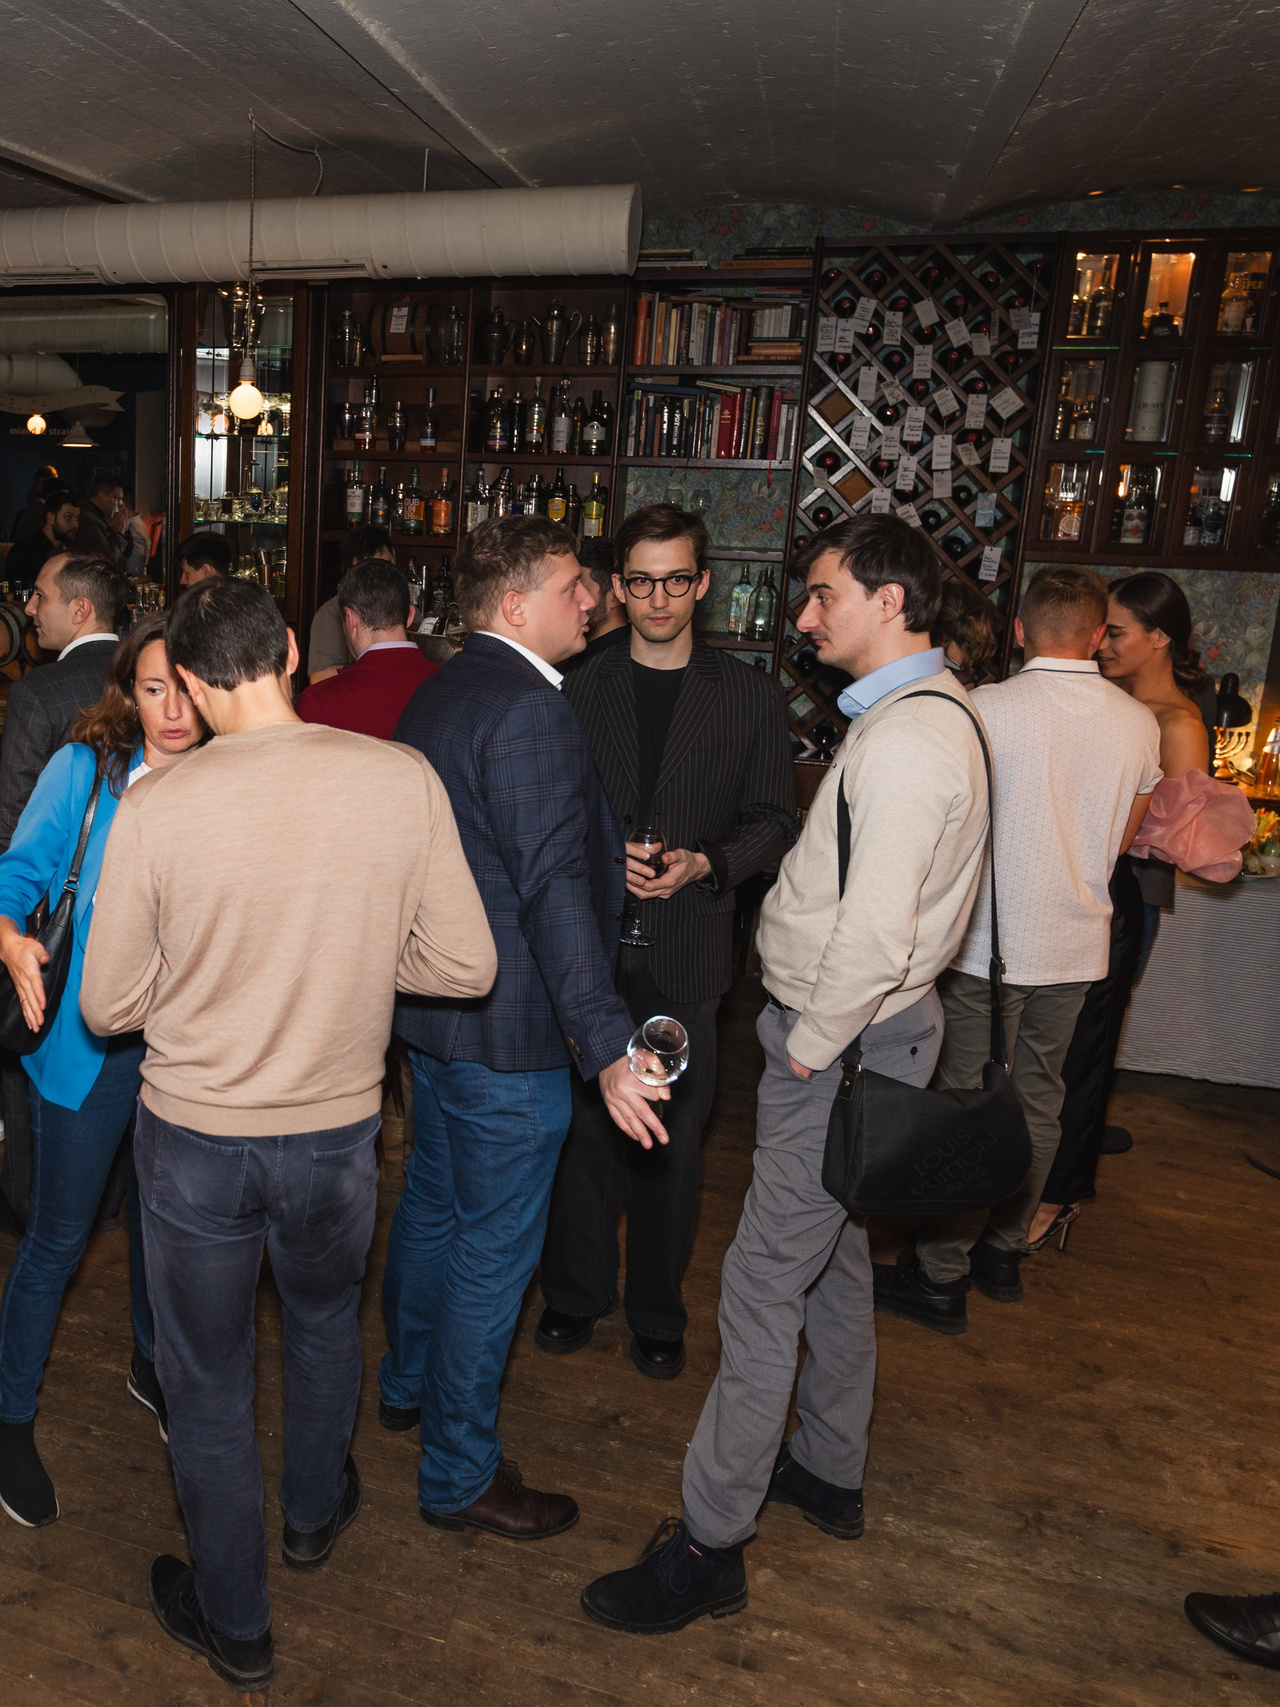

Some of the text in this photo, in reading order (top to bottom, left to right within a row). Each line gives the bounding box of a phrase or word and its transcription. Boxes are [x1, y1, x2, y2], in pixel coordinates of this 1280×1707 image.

[910, 1131, 999, 1196] VUITTON
[913, 1130, 970, 1177] LOUIS
[946, 1166, 986, 1195] PARIS
